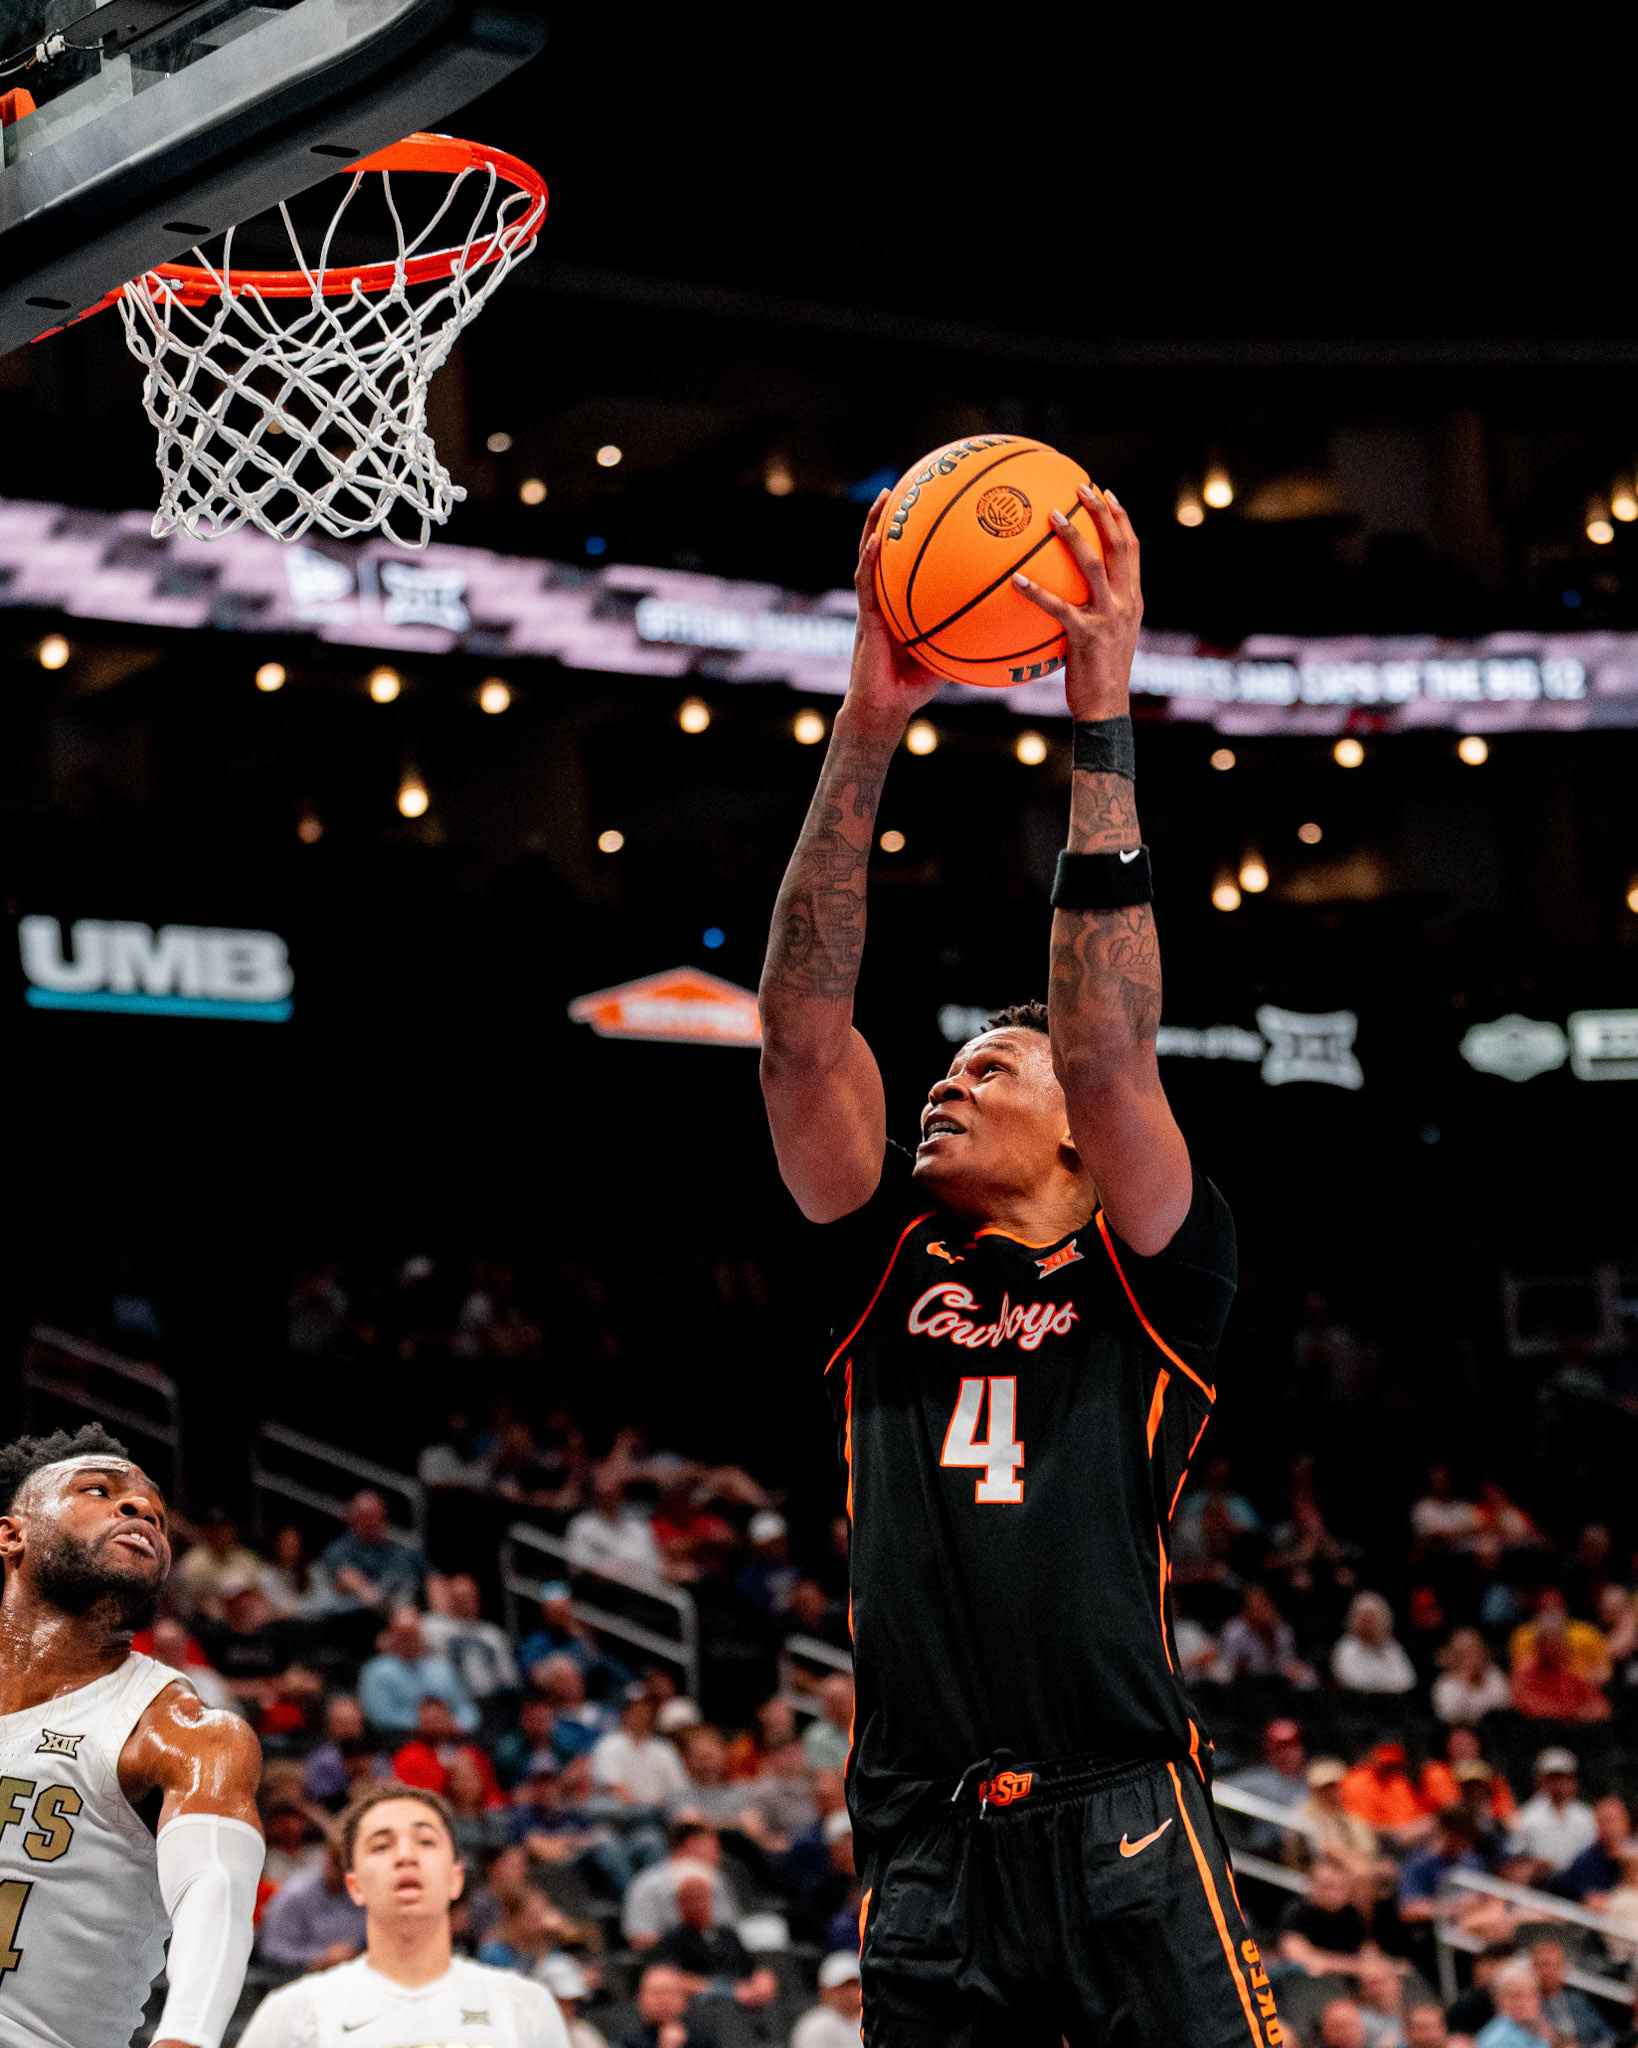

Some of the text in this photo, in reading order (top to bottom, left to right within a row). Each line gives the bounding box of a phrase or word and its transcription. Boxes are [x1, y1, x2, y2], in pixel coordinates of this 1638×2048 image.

[18, 914, 295, 1003] UMB
[908, 1281, 1080, 1350] Cowboys
[939, 1375, 1025, 1504] 4
[35, 1728, 86, 1759] XII
[1241, 1939, 1284, 2048] OKES
